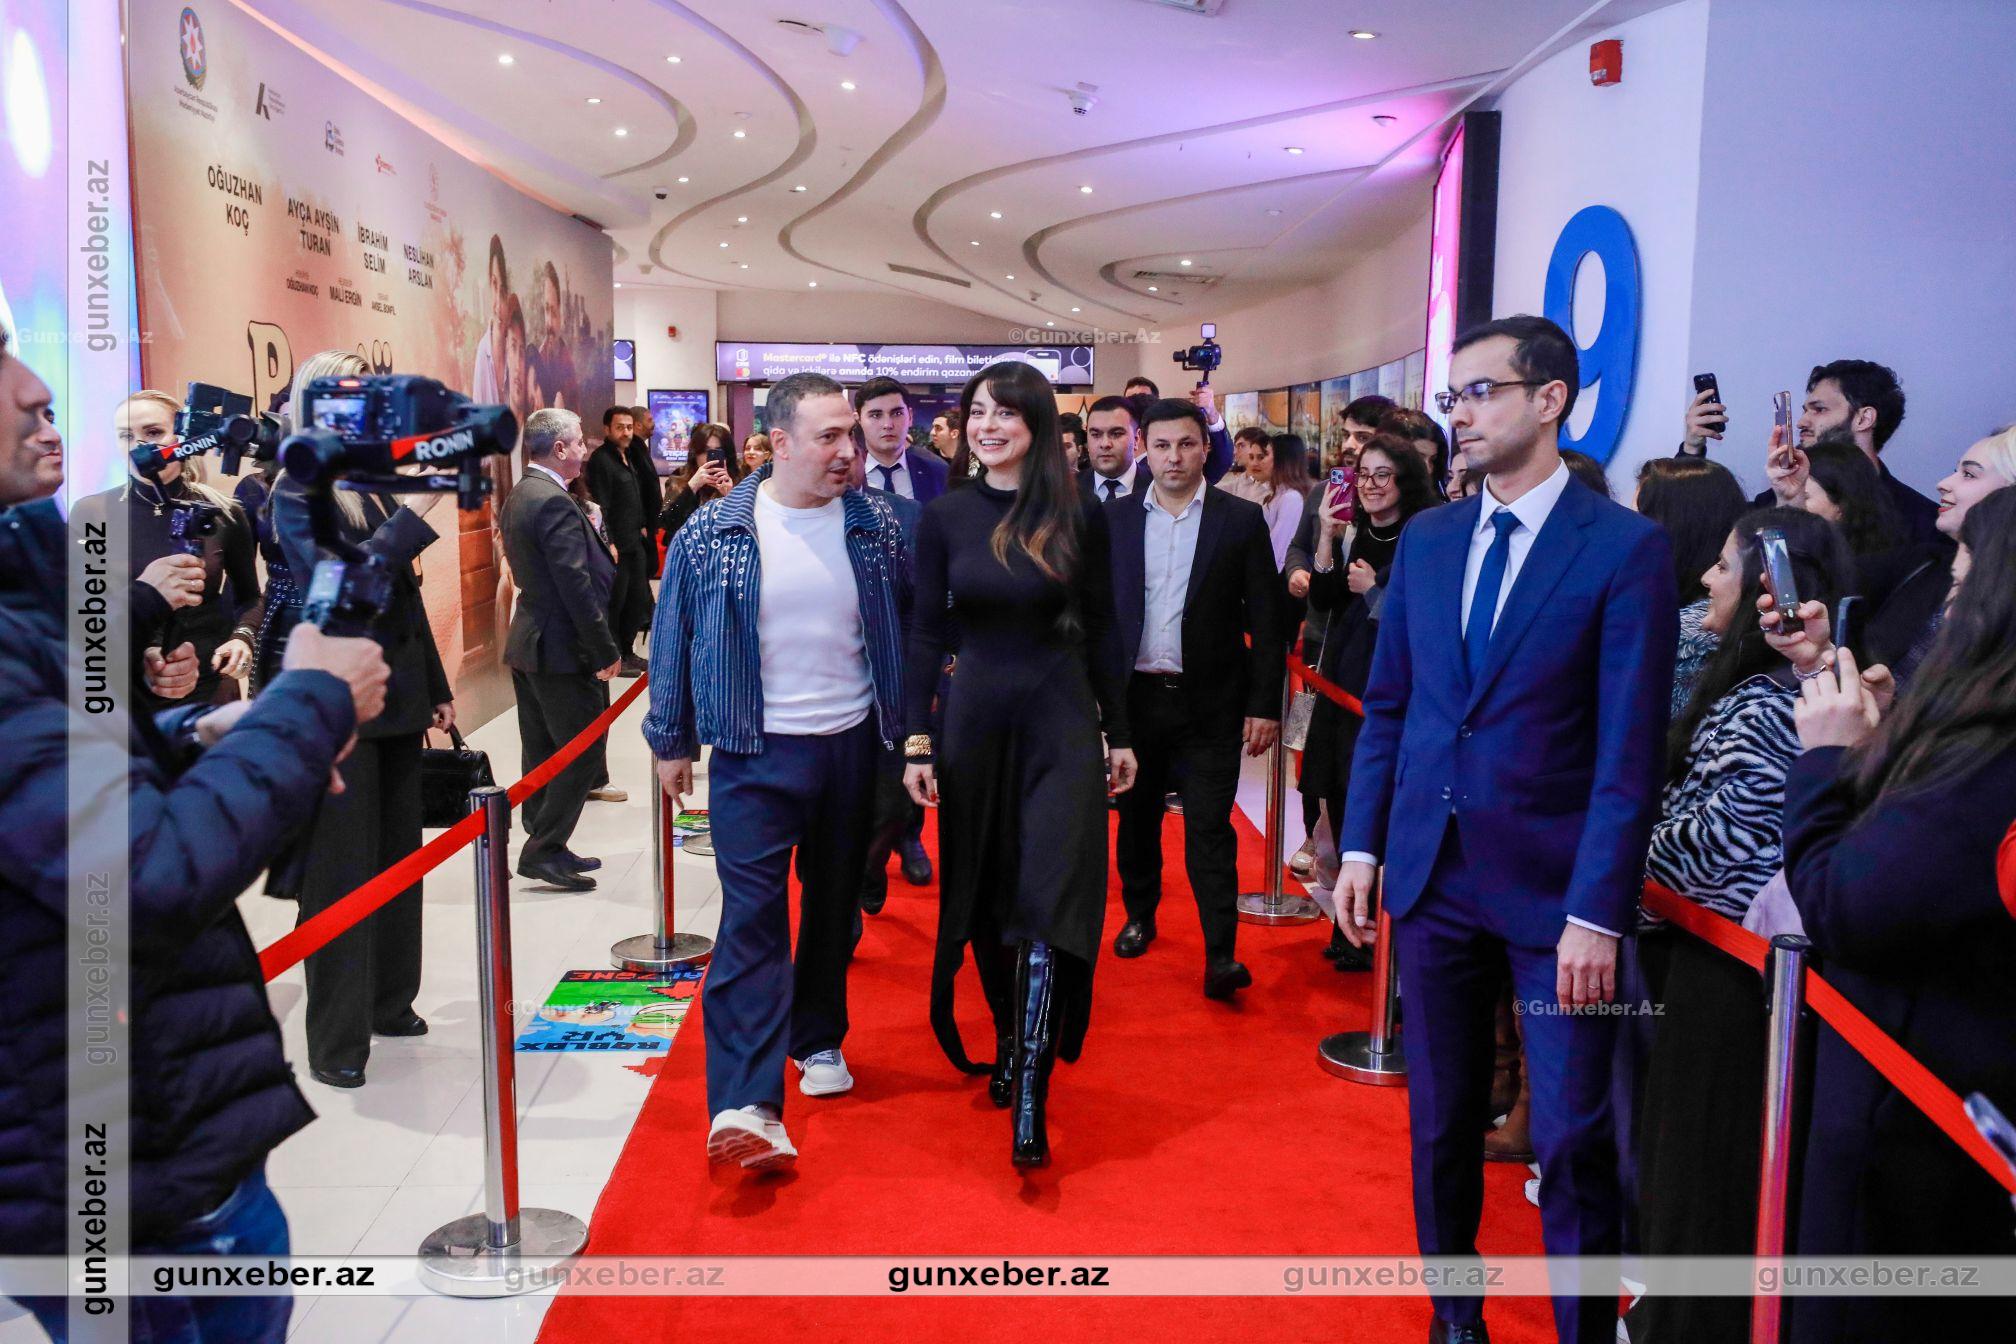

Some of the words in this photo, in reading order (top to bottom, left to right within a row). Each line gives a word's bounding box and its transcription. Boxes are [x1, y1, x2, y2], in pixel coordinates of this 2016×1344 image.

[208, 165, 262, 205] OĞUZHAN
[226, 203, 249, 236] KOÇ
[288, 198, 312, 227] AYÇA
[314, 209, 339, 236] AYŞİN
[300, 230, 331, 256] TURAN
[357, 220, 388, 251] İBRAHİM
[363, 252, 386, 274] SELİM
[403, 243, 434, 269] NESLİHAN
[408, 267, 433, 289] ARSLAN
[1543, 205, 1641, 468] 9
[763, 366, 785, 376] qida
[839, 367, 873, 376] anında
[876, 367, 898, 376] 10%
[900, 367, 939, 376] endirim
[843, 353, 866, 363] NFC
[918, 355, 942, 365] edin,
[945, 355, 964, 364] film
[173, 434, 218, 458] RONIN
[415, 429, 474, 460] RONIN
[517, 1041, 661, 1050] ROBLOX
